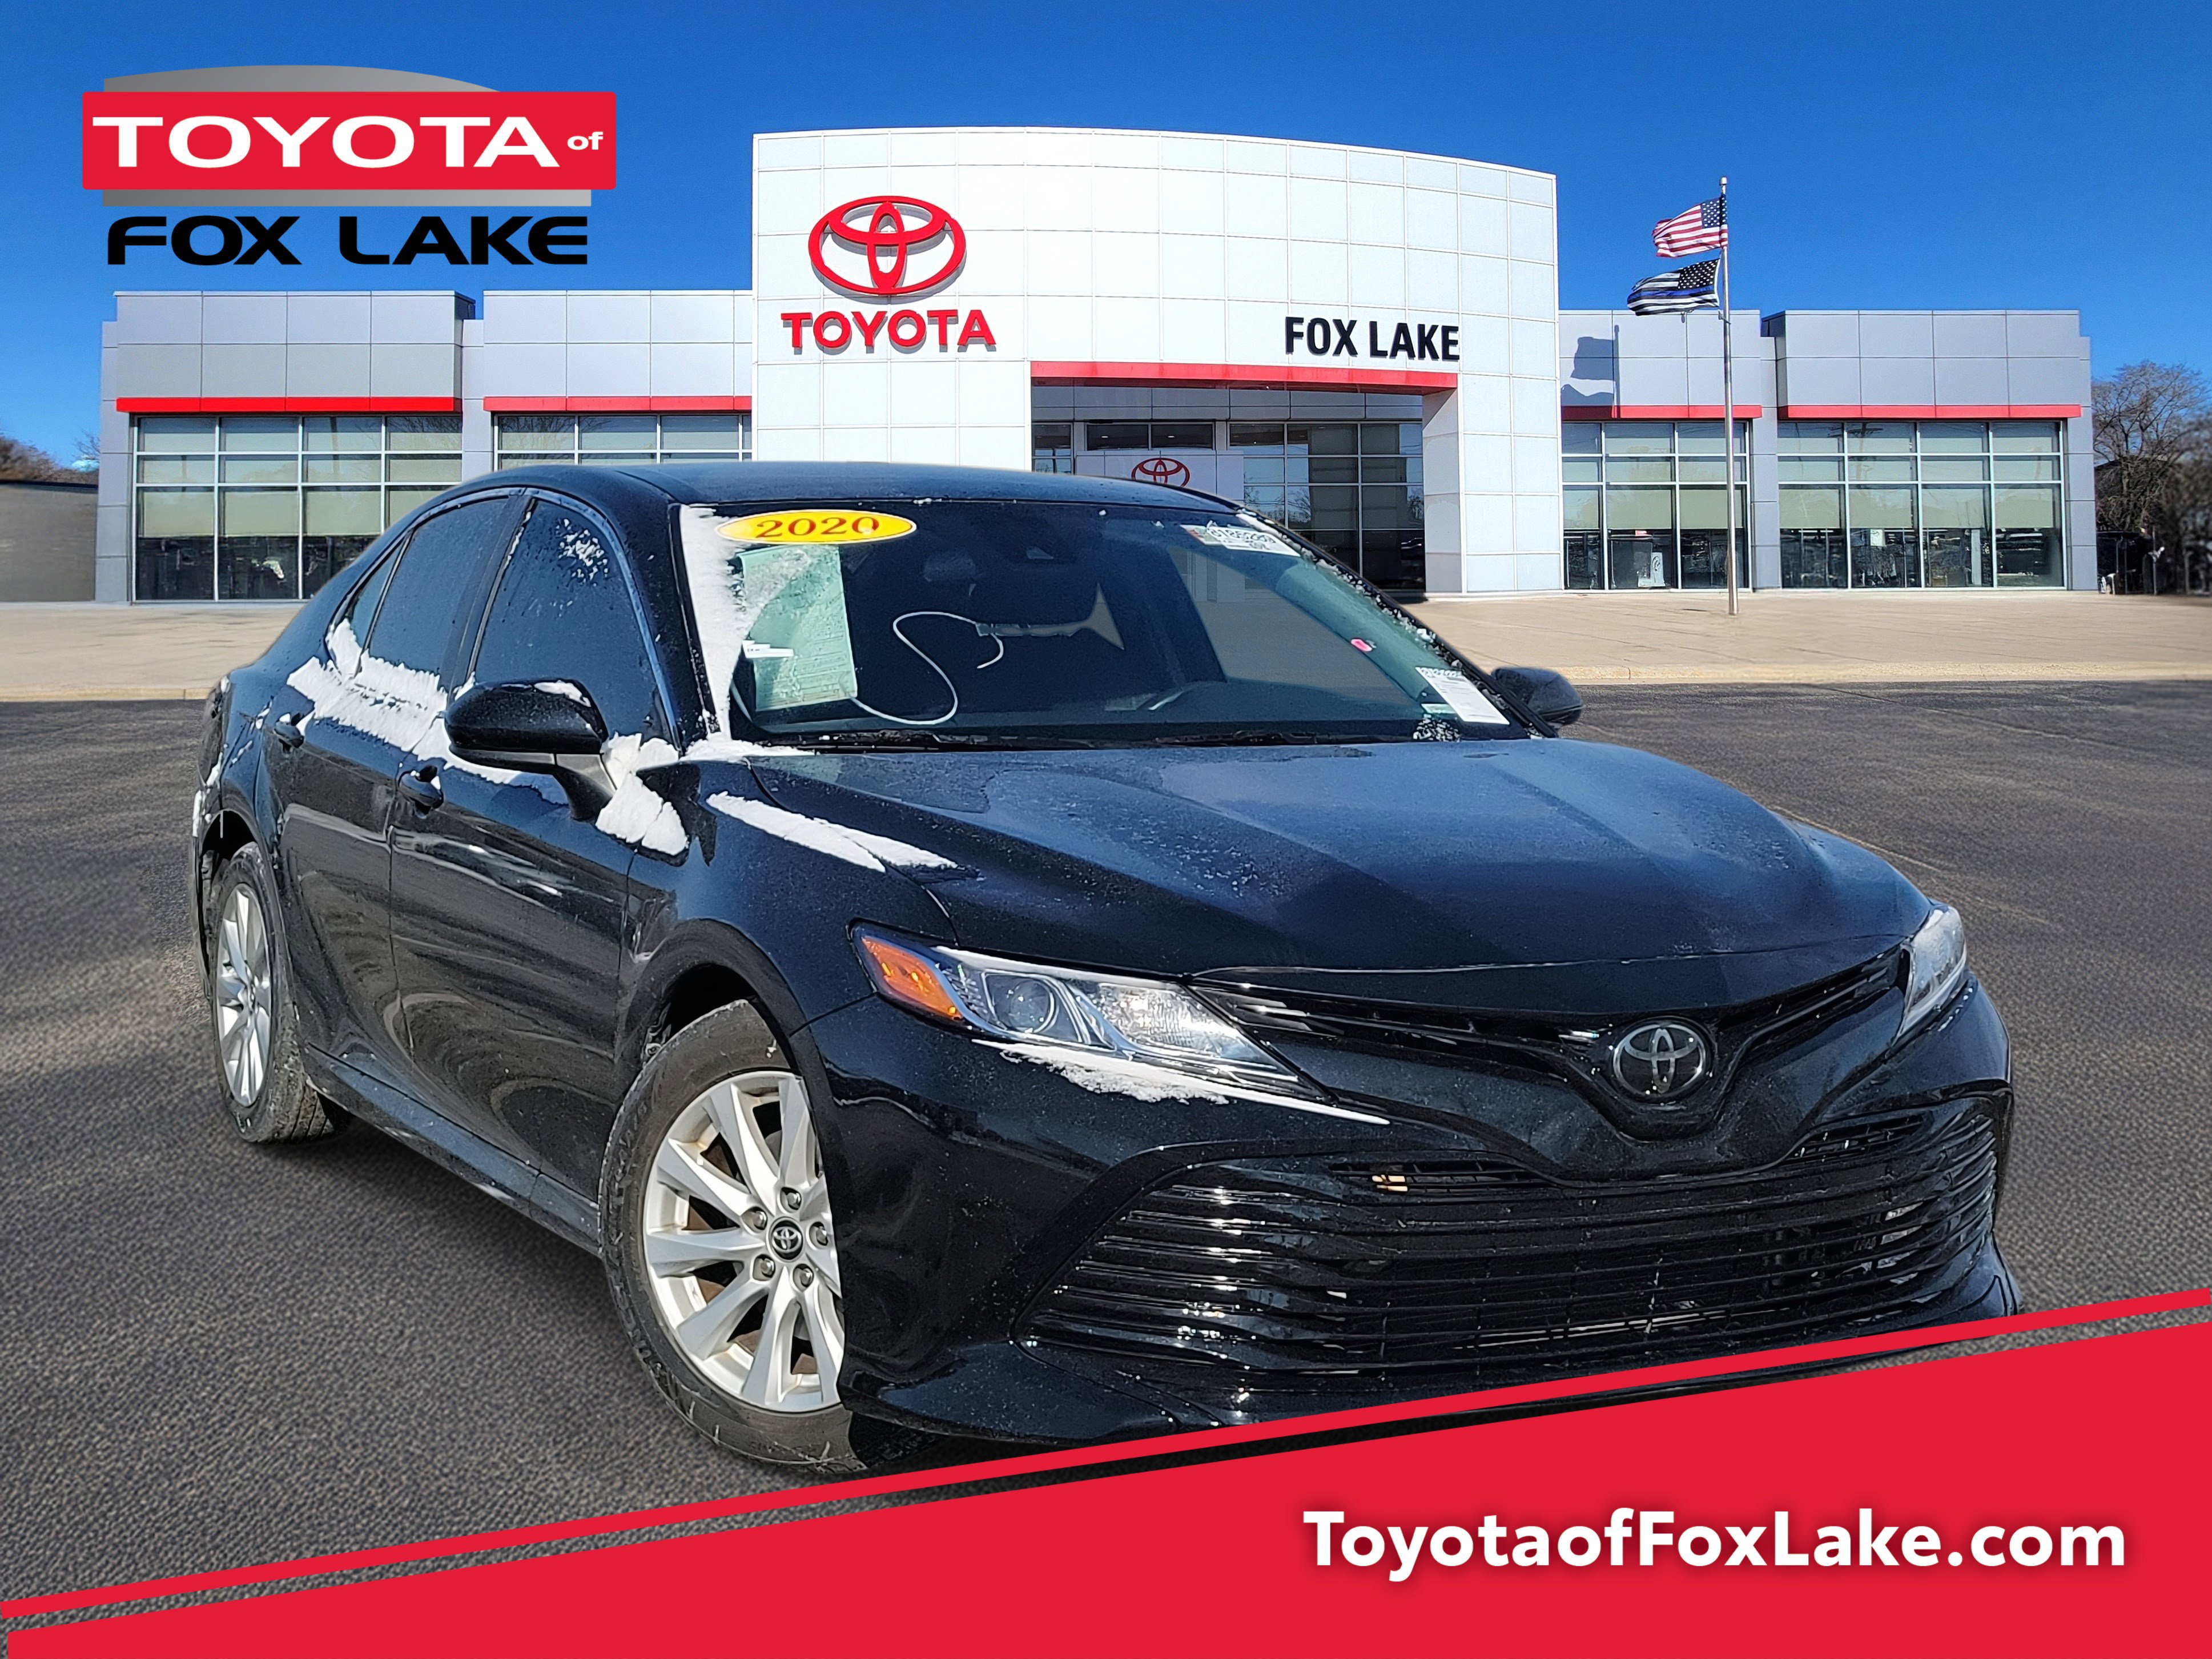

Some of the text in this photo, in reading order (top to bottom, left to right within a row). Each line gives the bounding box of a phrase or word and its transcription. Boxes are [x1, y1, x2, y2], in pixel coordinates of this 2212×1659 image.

[780, 308, 997, 350] TOYOTA
[1285, 316, 1460, 362] FOX LAKE
[755, 516, 879, 538] 2020
